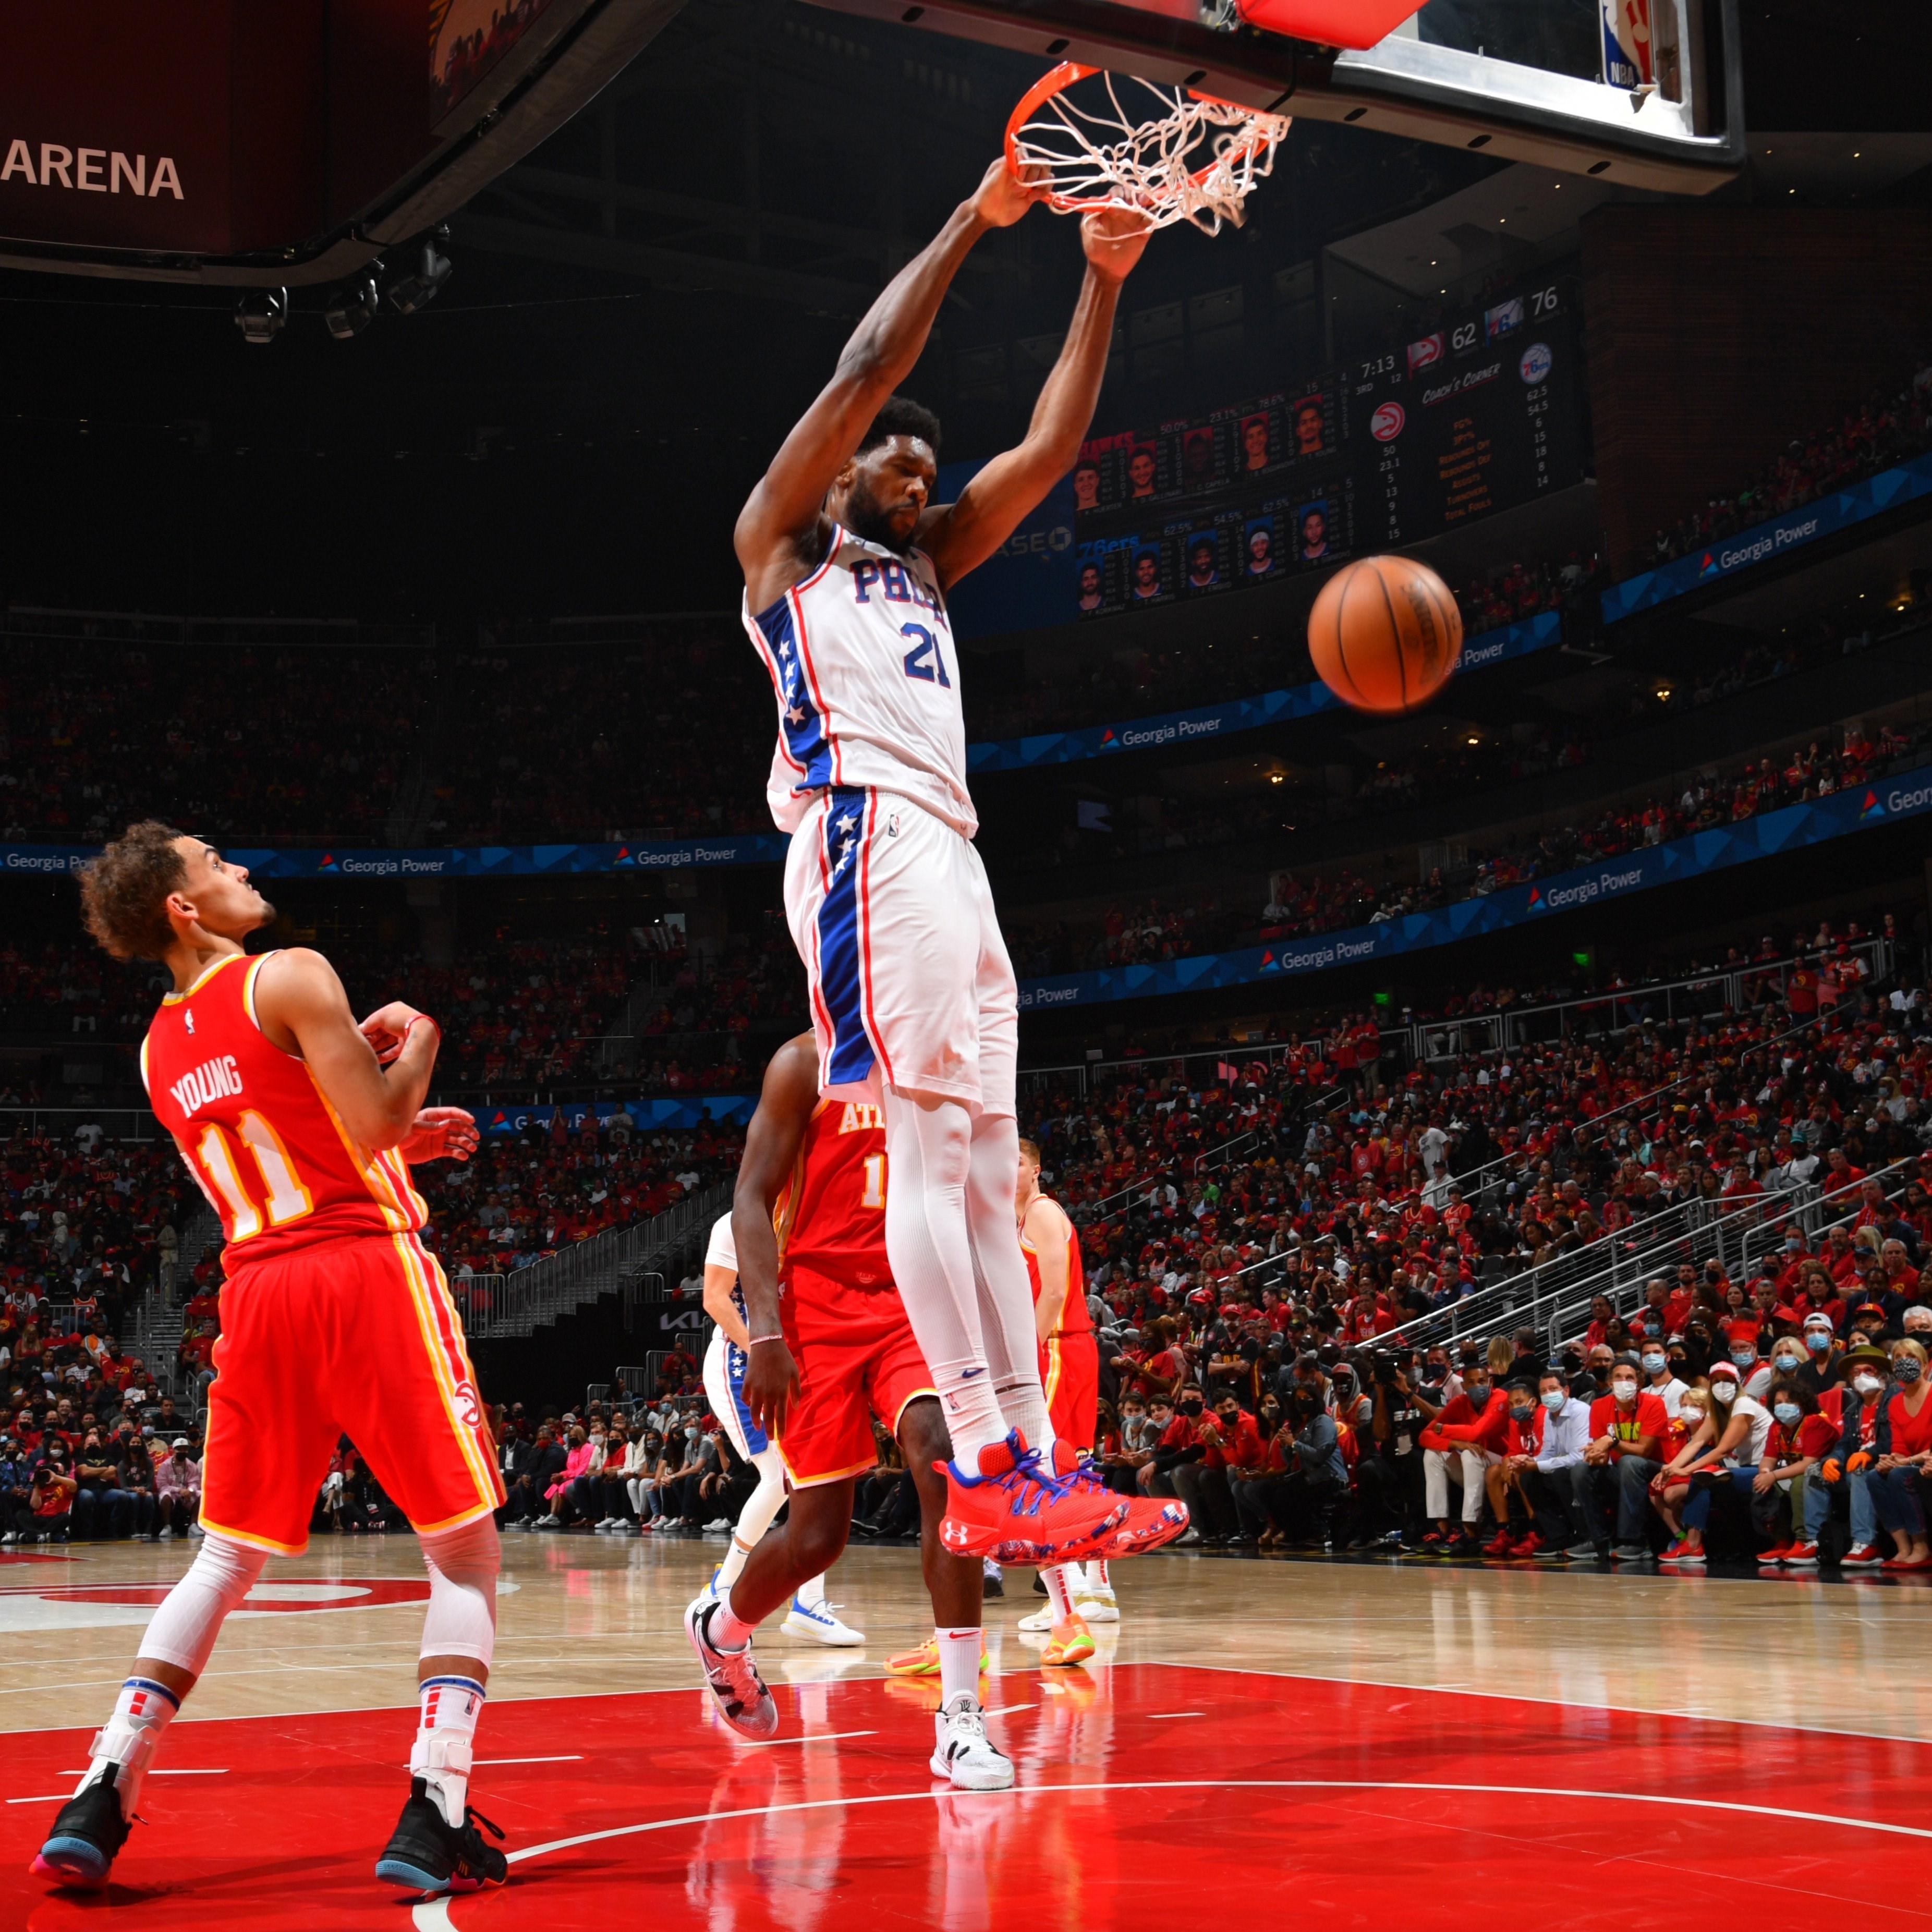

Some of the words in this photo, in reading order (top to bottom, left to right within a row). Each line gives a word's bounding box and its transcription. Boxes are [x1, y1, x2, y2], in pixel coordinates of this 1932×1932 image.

[1610, 61, 1635, 87] NBA
[0, 139, 185, 200] ARENA
[1532, 286, 1557, 316] 76
[1452, 322, 1476, 350] 62
[1362, 355, 1395, 379] 7:13
[1391, 373, 1402, 384] 12
[1307, 382, 1318, 394] 15
[1356, 383, 1374, 395] 3RD
[1526, 385, 1548, 402] 62.5
[1259, 394, 1285, 409] 78.6%
[1527, 400, 1549, 416] 54.5
[1210, 409, 1238, 423] 23.1%
[1535, 417, 1542, 428] 6
[1160, 421, 1188, 435] 50.0%
[1535, 431, 1546, 444] 15
[1383, 445, 1396, 457] 50
[1535, 445, 1547, 458] 18
[1379, 457, 1400, 472] 23.1
[1538, 460, 1545, 472] 8
[1387, 473, 1394, 483] 5
[1537, 475, 1549, 488] 14
[1311, 488, 1323, 499] 14
[1386, 487, 1398, 497] 13
[1263, 498, 1289, 513] 62.5%
[1388, 501, 1395, 511] 9
[1214, 512, 1243, 526] 54.5%
[1389, 515, 1397, 525] 8
[1164, 523, 1193, 537] 62.5%
[1389, 528, 1401, 540] 15
[1721, 537, 1773, 568] Georgia
[1775, 518, 1818, 547] Power
[900, 622, 951, 689] 21
[1464, 642, 1504, 666] Power
[1122, 725, 1175, 745] Georgia
[1179, 718, 1221, 736] Power
[7, 853, 65, 871] Georgia
[638, 850, 691, 866] Georgia
[695, 848, 736, 862] Power
[343, 859, 398, 875] Georgia
[402, 859, 445, 872] Power
[1548, 879, 1598, 907] Georgia
[1600, 869, 1642, 893] Power
[1282, 946, 1334, 969] Georgia
[1336, 940, 1376, 959] Power
[1036, 988, 1079, 1004] Power
[170, 1054, 243, 1119] YOUNG
[196, 1109, 314, 1244] 11
[861, 1151, 885, 1209] 1
